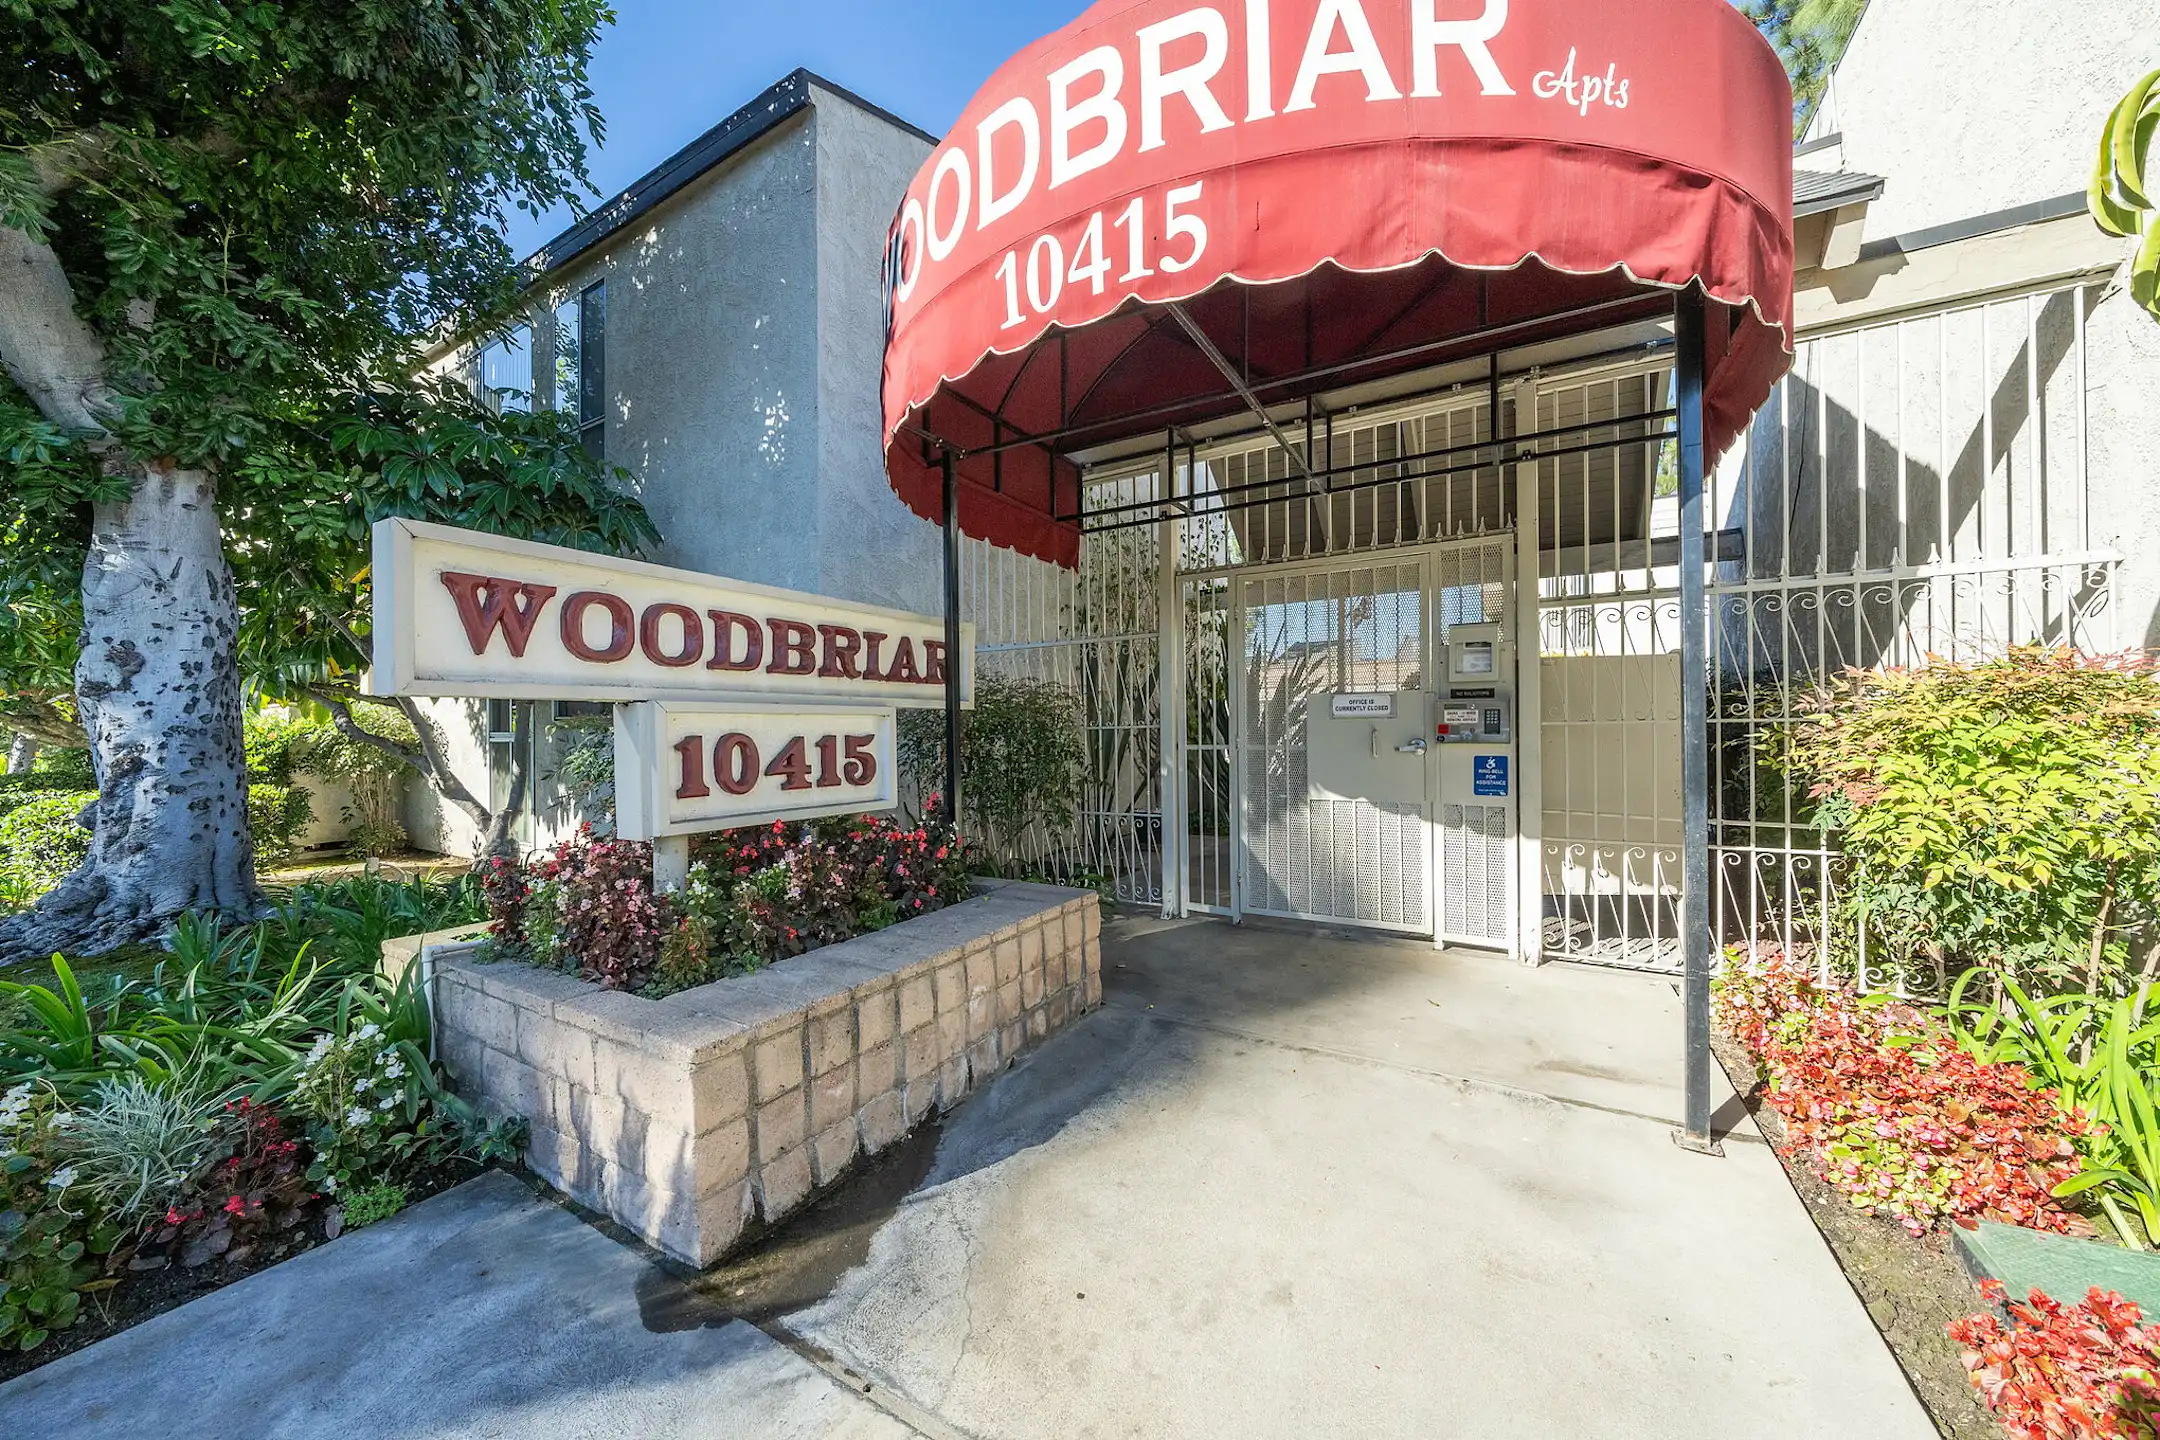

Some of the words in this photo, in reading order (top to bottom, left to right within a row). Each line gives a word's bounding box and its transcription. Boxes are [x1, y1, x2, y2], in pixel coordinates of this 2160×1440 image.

[883, 0, 1516, 302] OODBRIAR
[1532, 46, 1629, 117] Apts
[995, 180, 1208, 330] 10415
[673, 732, 877, 800] 10415
